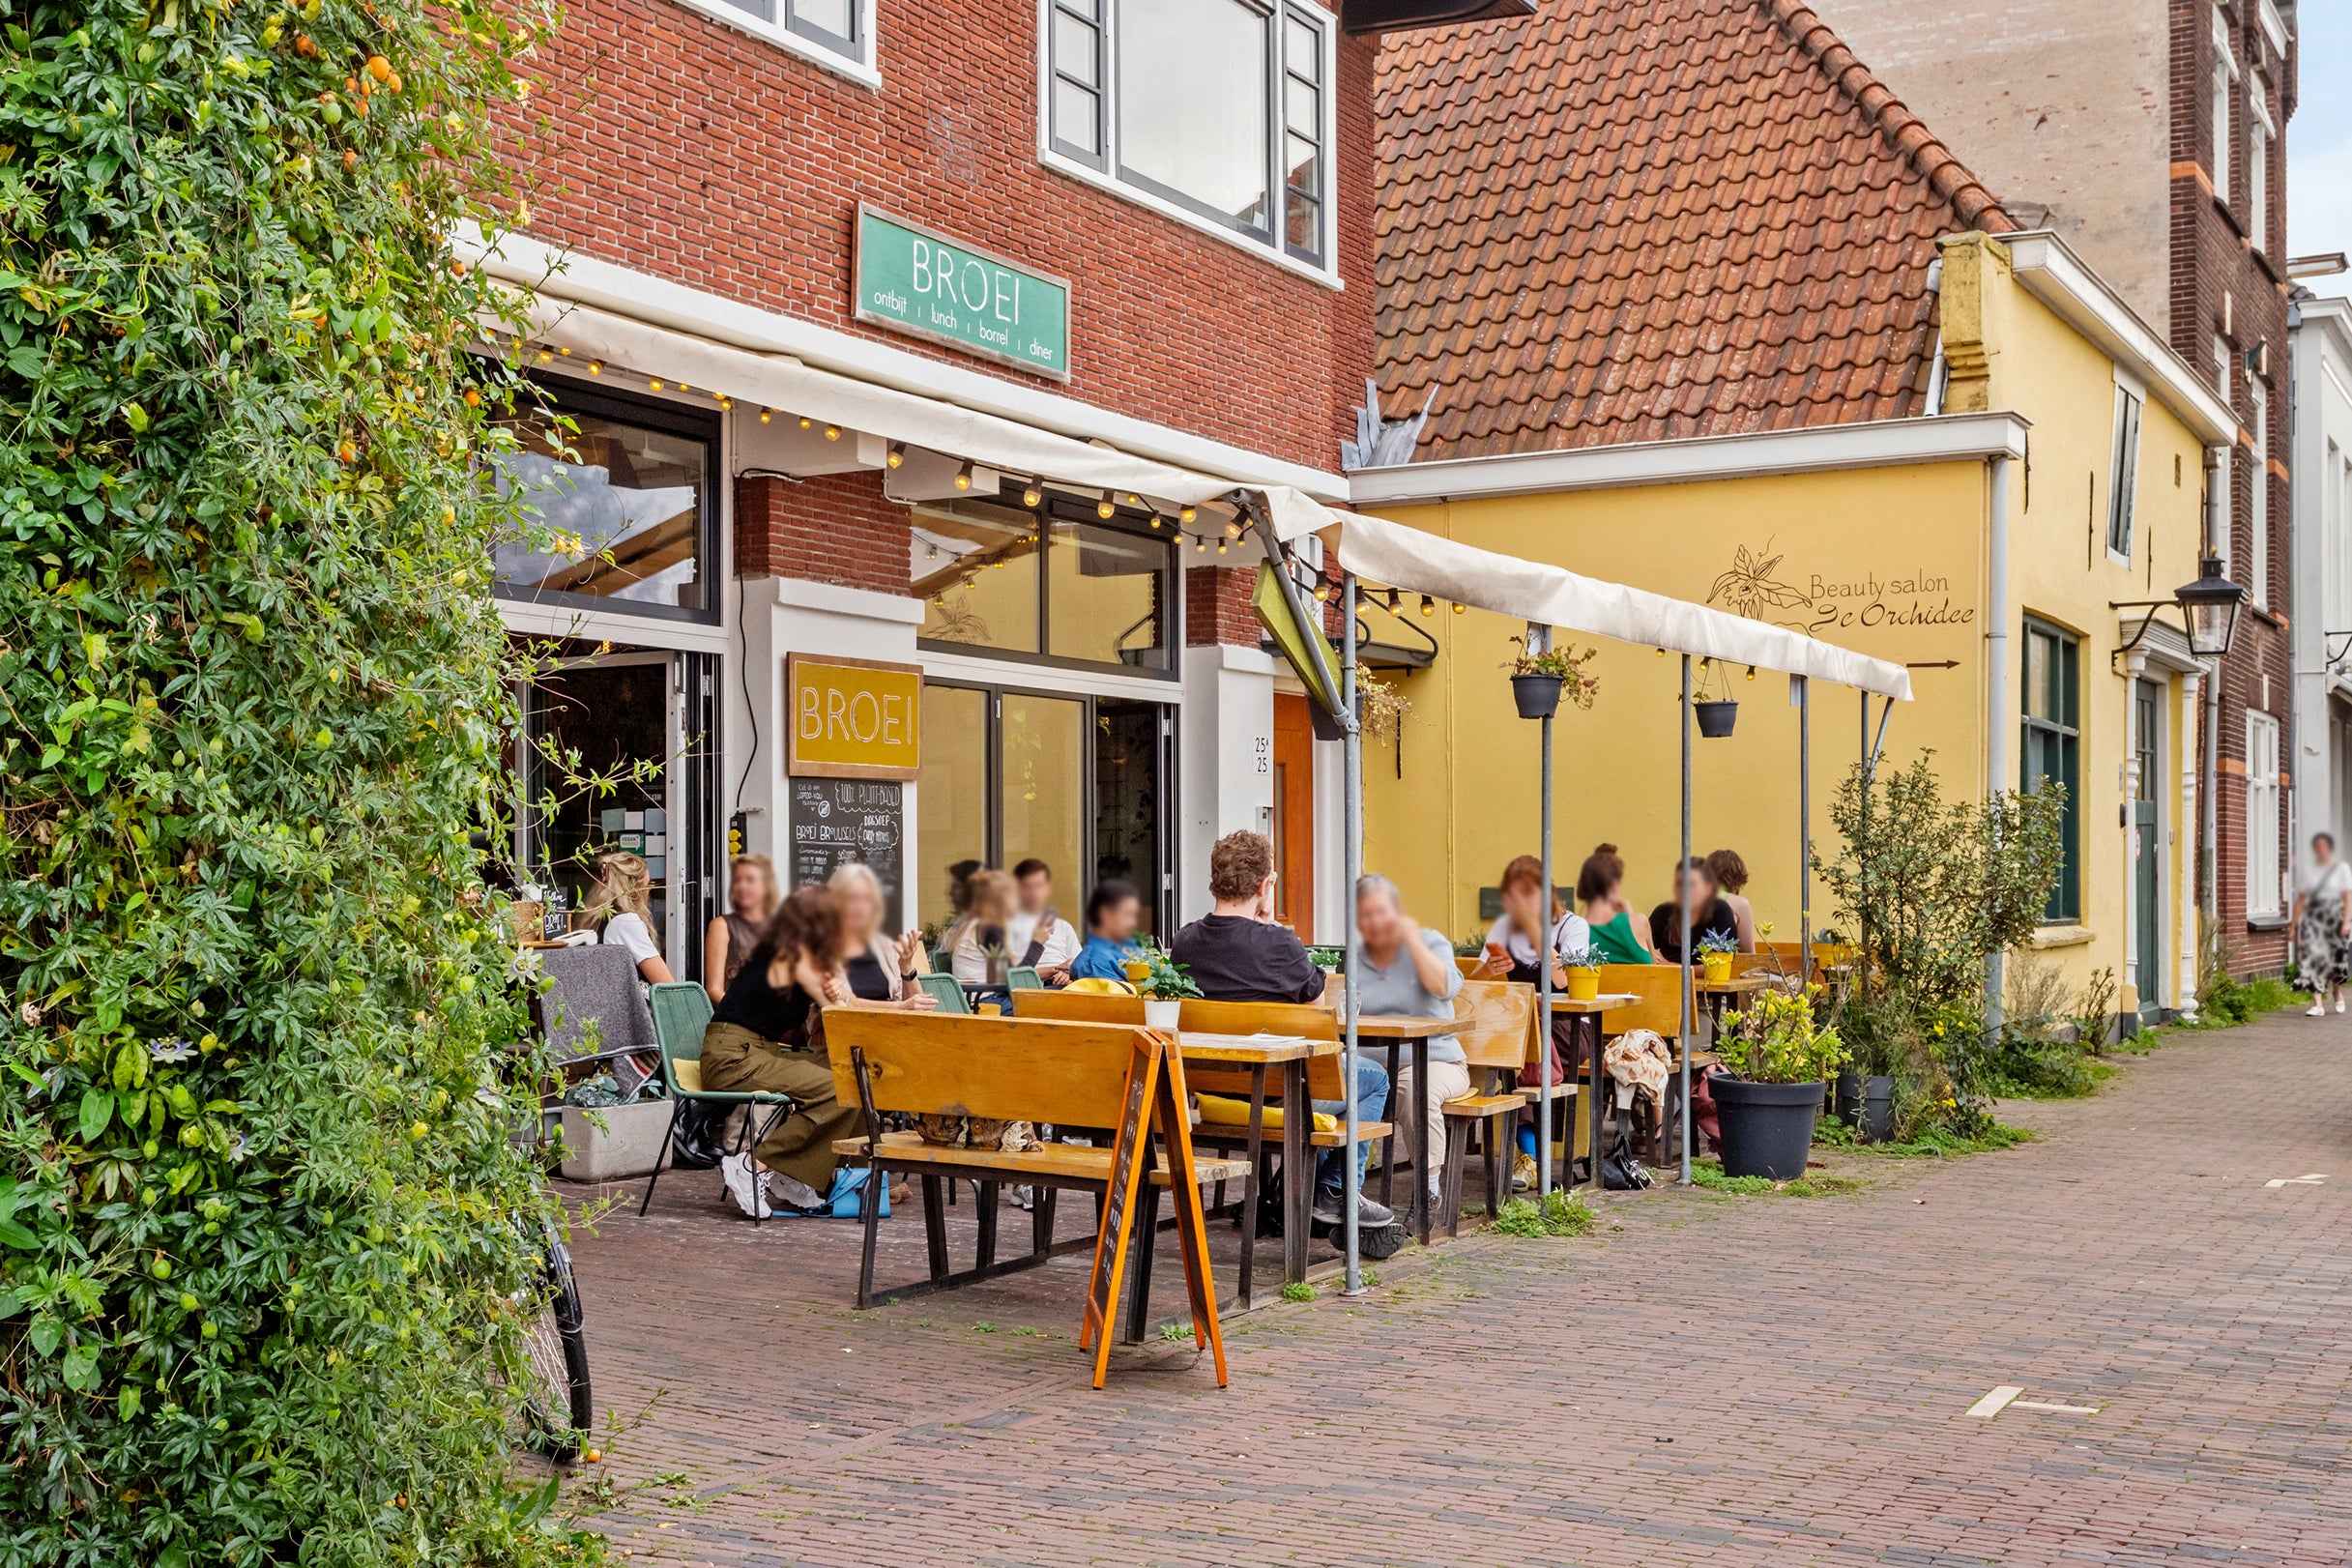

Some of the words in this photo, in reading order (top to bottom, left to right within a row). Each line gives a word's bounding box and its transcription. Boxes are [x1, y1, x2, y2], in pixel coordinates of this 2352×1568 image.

[913, 240, 1020, 325] BROEI
[874, 290, 907, 316] ontbijt
[931, 304, 957, 330] lunch
[979, 320, 1008, 346] borrel
[1030, 338, 1054, 361] diner
[1810, 572, 1885, 603] Beauty
[1891, 568, 1949, 595] salon
[1861, 597, 1974, 627] Orchidee
[801, 687, 912, 745] BROEI
[1258, 757, 1267, 772] 25
